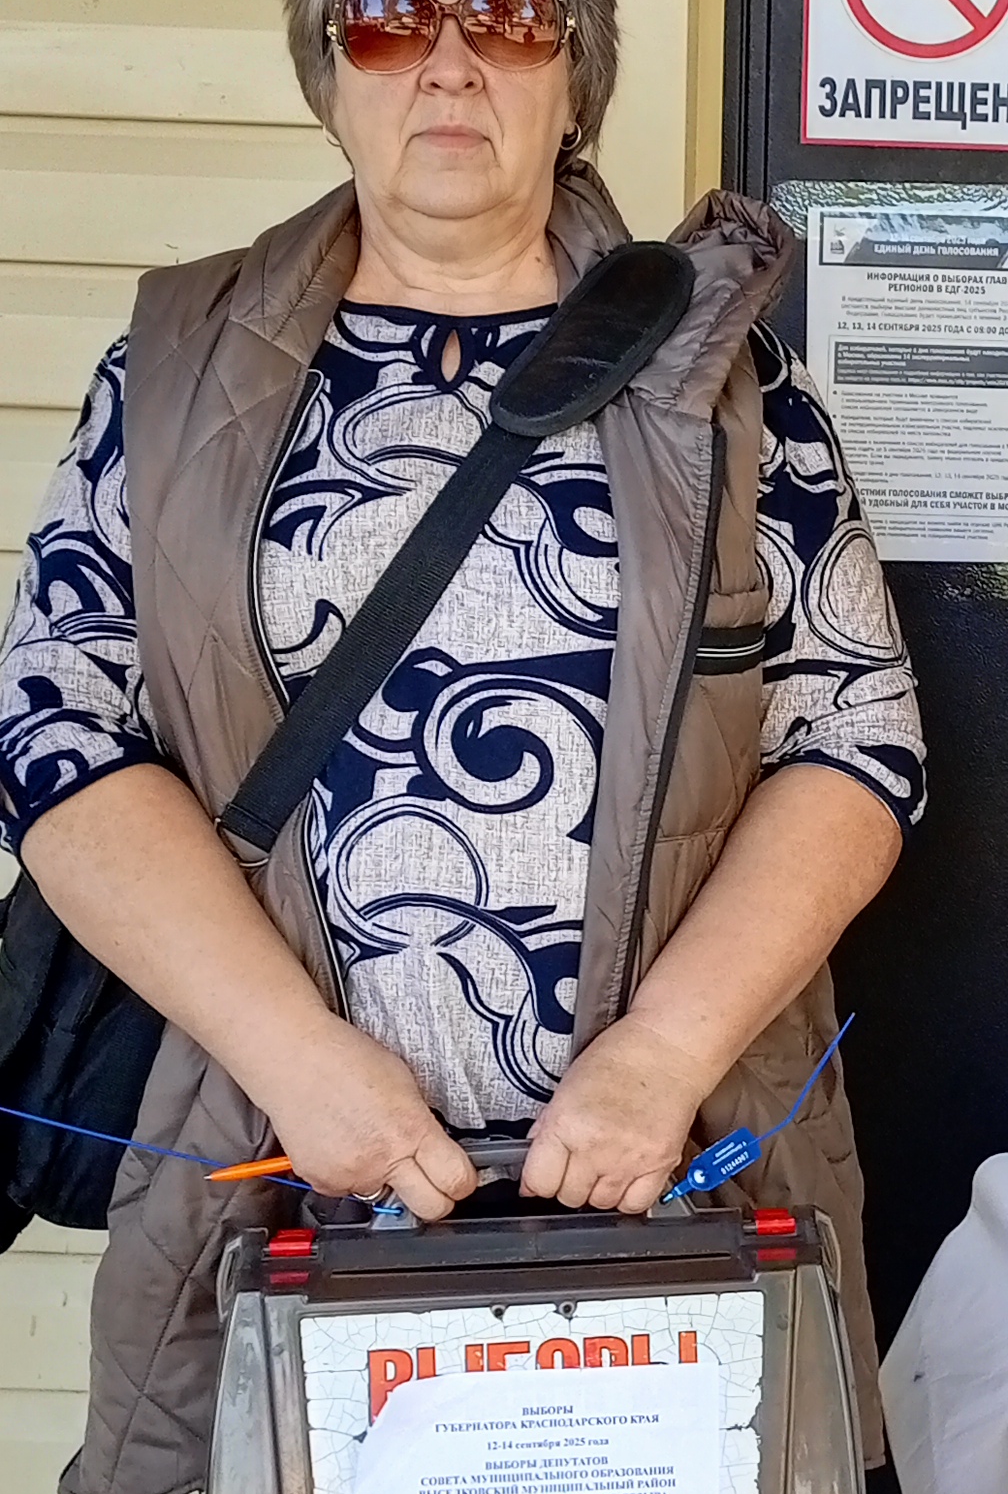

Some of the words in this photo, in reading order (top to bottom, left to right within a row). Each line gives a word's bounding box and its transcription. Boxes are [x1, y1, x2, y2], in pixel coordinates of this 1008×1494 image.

[874, 243, 911, 254] ЕДИНЫЙ
[913, 245, 936, 255] ДЕНЬ
[937, 246, 999, 256] ГОЛОСОВАНИЯ
[867, 272, 930, 283] ИНФОРМАЦИЯ
[941, 274, 983, 284] ВЫБОРАХ
[985, 276, 1007, 285] ГЛАВ
[888, 283, 934, 293] РЕГИОНОВ
[878, 323, 920, 331] СЕНТЯБРЯ
[921, 324, 942, 333] 2025
[944, 325, 964, 334] ГОДА
[888, 489, 947, 498] ГОЛОСОВАНИЯ
[949, 491, 983, 500] СМОЖЕТ
[868, 498, 909, 508] УДОБНЫЙ
[910, 500, 928, 509] ДЛЯ
[953, 501, 988, 510] УЧАСТОК
[522, 1405, 573, 1416] ВЫБОРЫ
[435, 1421, 517, 1433] ГУБЕРНАТОРА
[521, 1416, 628, 1429] КРАСНОДАРСКОГО
[630, 1414, 659, 1424] КРАЯ
[487, 1441, 513, 1450] 12-14
[563, 1437, 586, 1447] 2025
[485, 1459, 537, 1470] ВЫБОРЫ
[539, 1456, 608, 1469] ДЕПУТАТОВ
[420, 1476, 467, 1486] СОВЕТА
[591, 1466, 674, 1478] ОБРАЗОВАНИЯ
[522, 1479, 634, 1494] МУНИЦИПАЛЬНЫЙ
[637, 1478, 676, 1488] РАЙОН
